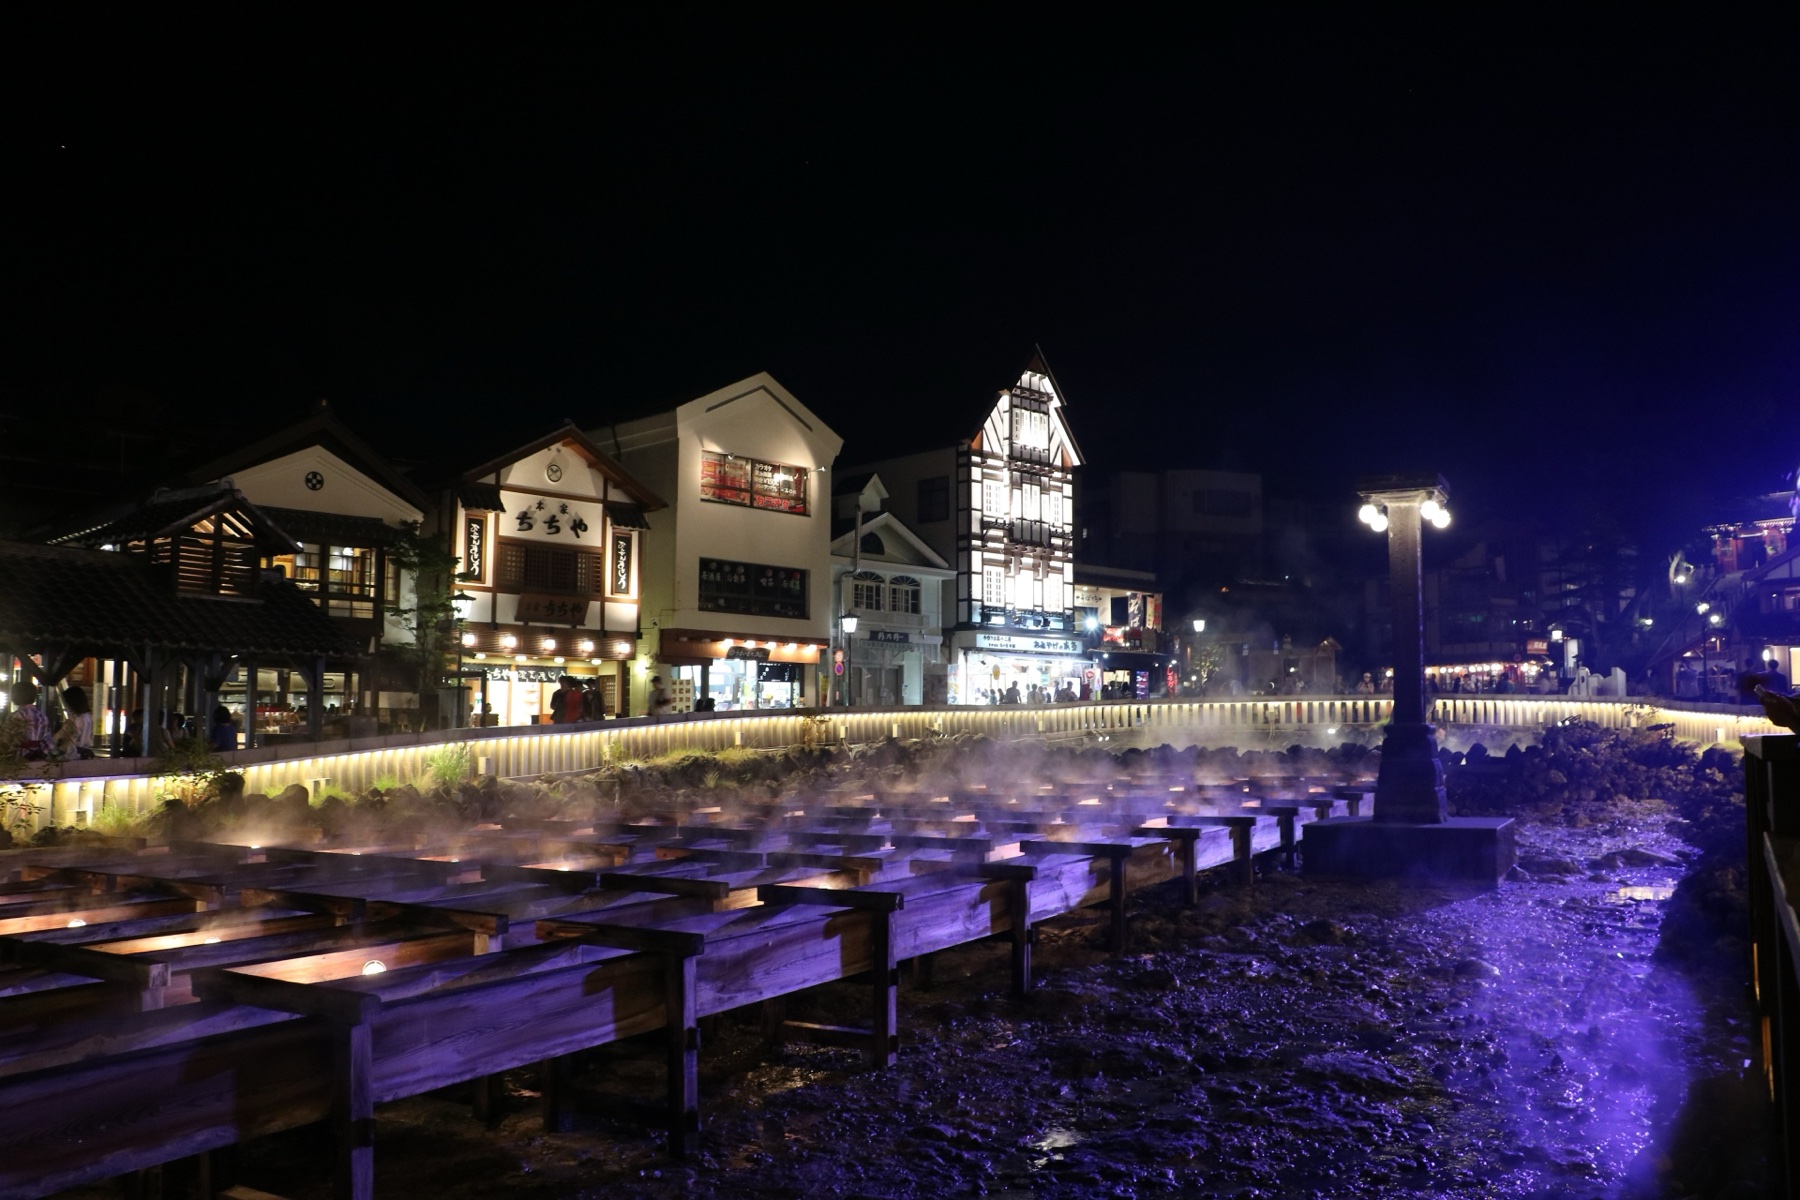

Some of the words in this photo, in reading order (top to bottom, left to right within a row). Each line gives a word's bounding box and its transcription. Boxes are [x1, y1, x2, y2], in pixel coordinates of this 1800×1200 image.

[536, 501, 568, 514] 本家
[516, 511, 588, 539] ちちや
[543, 600, 583, 618] ちちや
